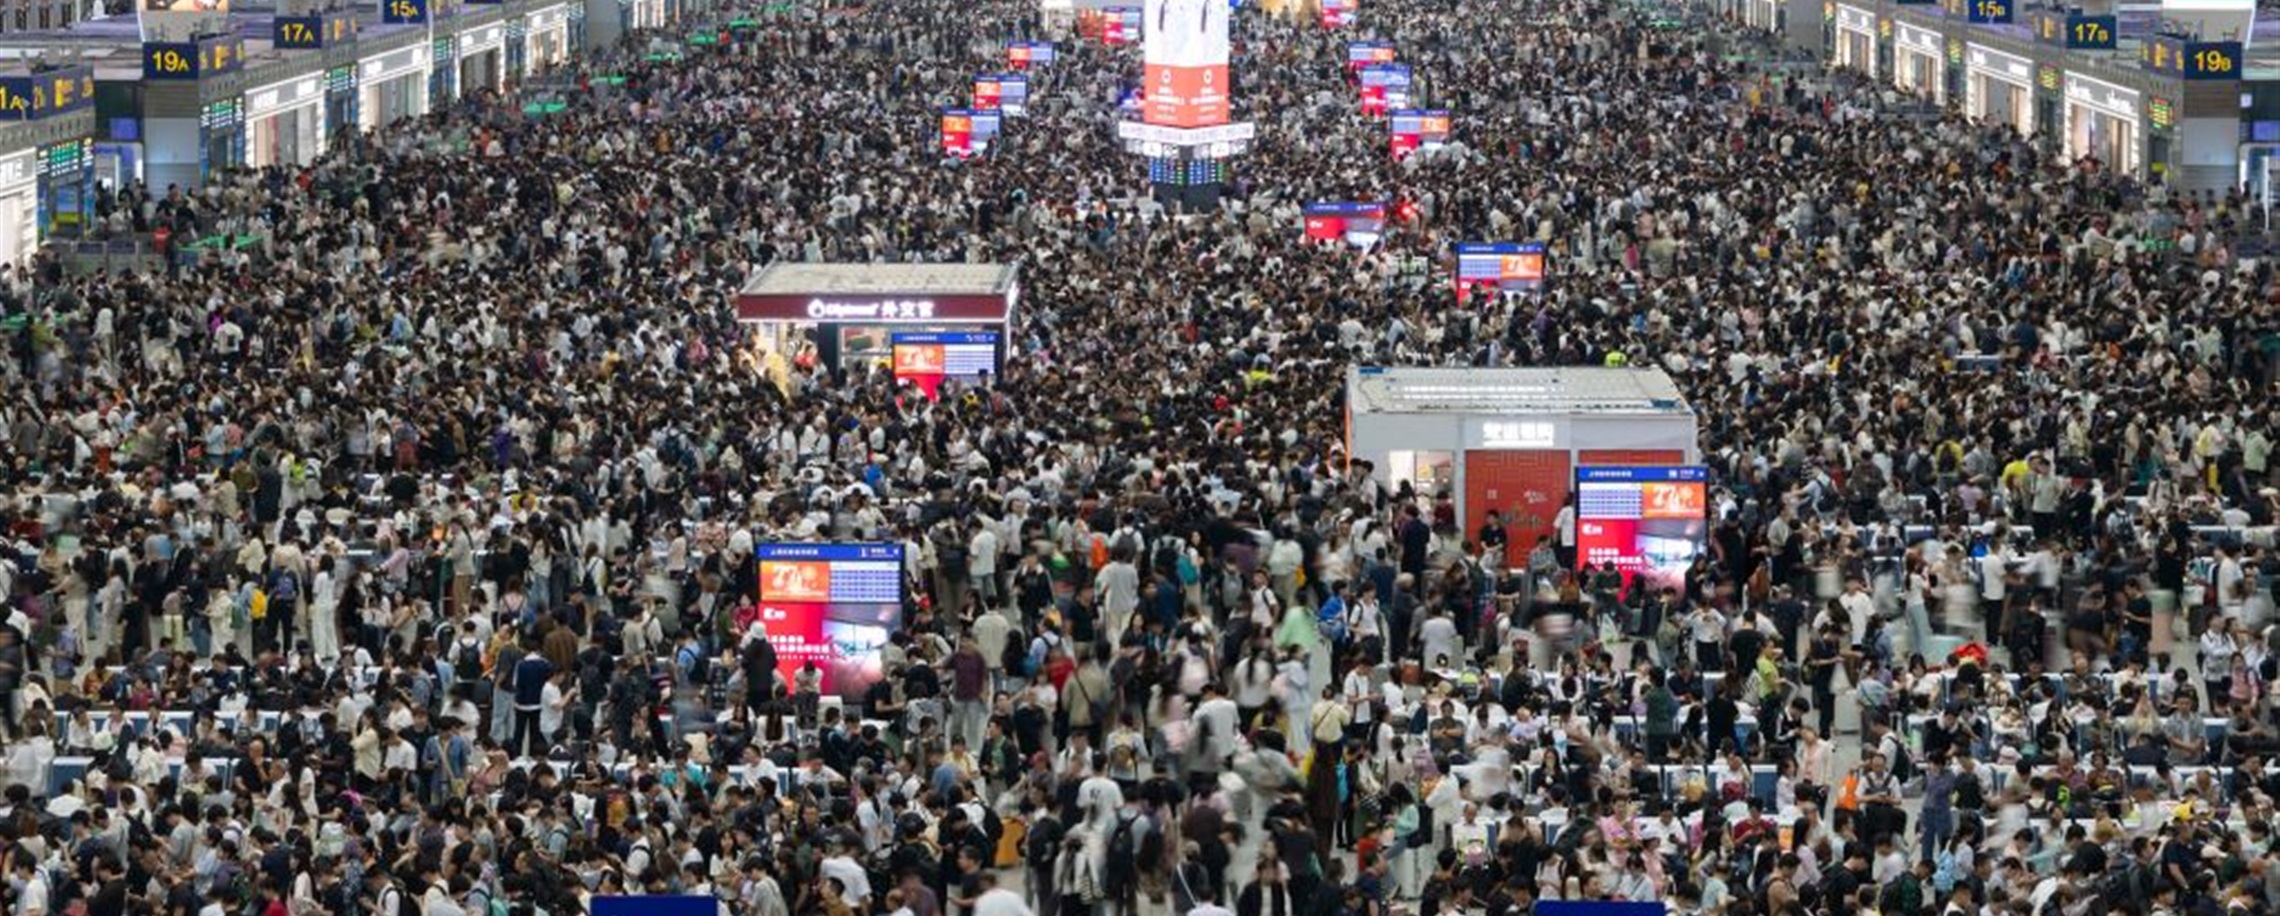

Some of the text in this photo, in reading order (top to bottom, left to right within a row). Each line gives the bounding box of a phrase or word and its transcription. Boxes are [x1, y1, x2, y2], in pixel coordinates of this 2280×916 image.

[391, 1, 417, 17] 15A
[1977, 1, 2005, 17] 15B
[282, 23, 314, 42] 17A
[2076, 23, 2109, 42] 17B
[153, 50, 190, 72] 19A
[2195, 50, 2232, 72] 19B
[881, 301, 934, 318] 外交官
